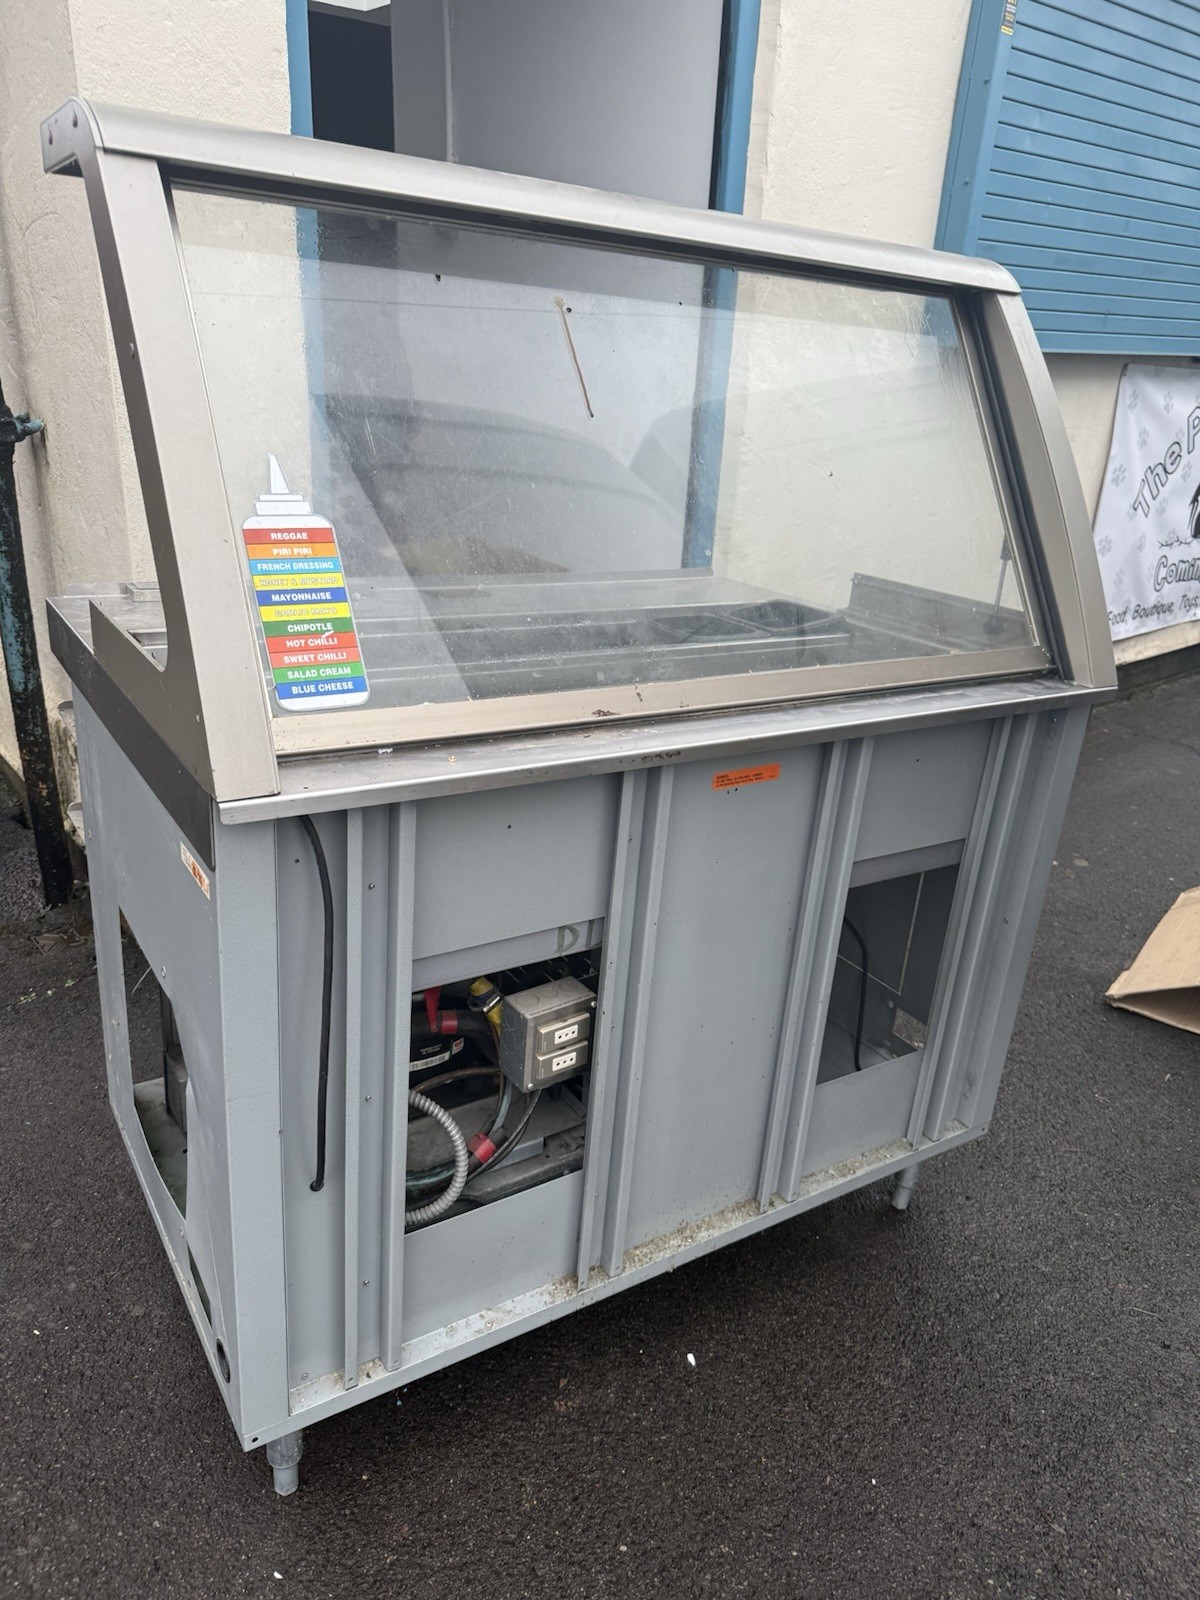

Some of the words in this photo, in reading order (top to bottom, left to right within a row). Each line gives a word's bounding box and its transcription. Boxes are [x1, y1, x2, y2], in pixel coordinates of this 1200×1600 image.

[1132, 441, 1182, 518] The
[270, 532, 309, 540] REGGAE
[272, 548, 292, 556] PIRI
[293, 547, 313, 555] PIRI
[257, 562, 291, 571] FRENCH
[292, 561, 334, 570] DRESSING
[1153, 555, 1200, 593] Comin
[259, 579, 289, 587] HONEY
[291, 578, 299, 586] &
[300, 577, 338, 585] MUSTARD
[271, 592, 332, 602] MAYONNAISE
[274, 608, 309, 617] GARLIC
[311, 607, 337, 615] MAYO
[287, 622, 334, 633] CHIPOTLE
[285, 639, 306, 648] HOT
[307, 637, 338, 647] CHILLI
[283, 653, 315, 664] SWEET
[317, 652, 347, 661] CHILLI
[287, 670, 318, 679] SALAD
[319, 666, 352, 677] CREAM
[291, 685, 317, 694] BLUE
[318, 681, 354, 692] CHEESE
